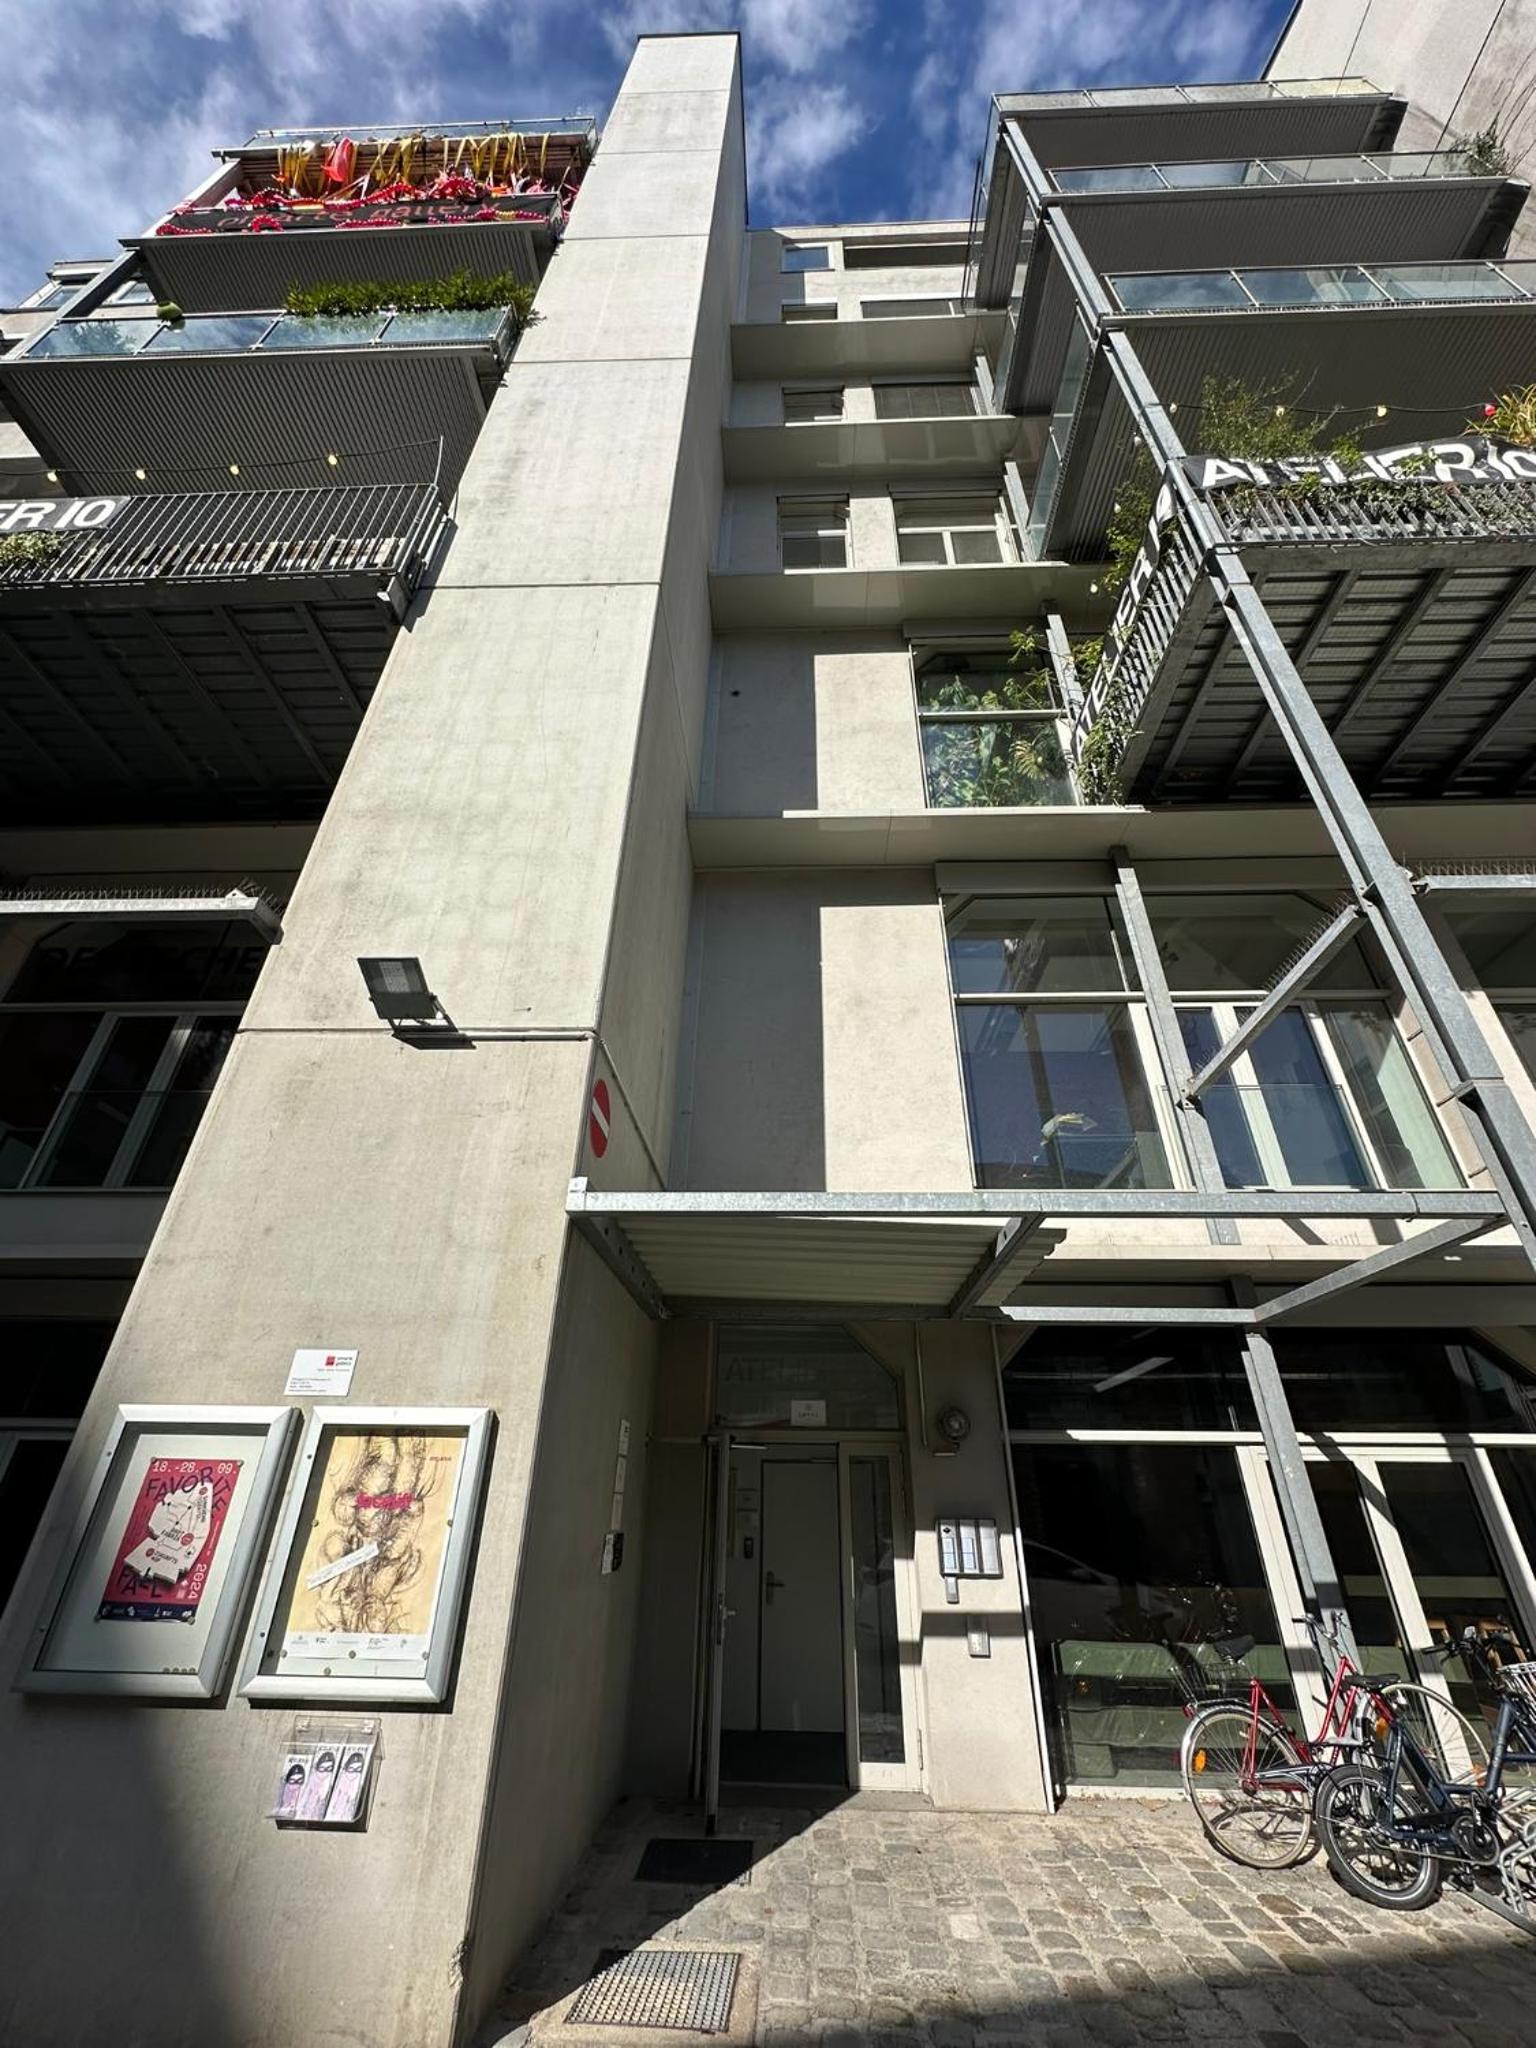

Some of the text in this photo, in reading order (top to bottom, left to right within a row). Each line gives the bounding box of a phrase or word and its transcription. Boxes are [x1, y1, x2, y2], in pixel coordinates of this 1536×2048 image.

[1202, 443, 1489, 488] ATELIER
[53, 499, 116, 529] 10
[217, 1463, 238, 1475] 09.
[145, 1466, 232, 1518] FAVORITE
[187, 1563, 208, 1600] 2024
